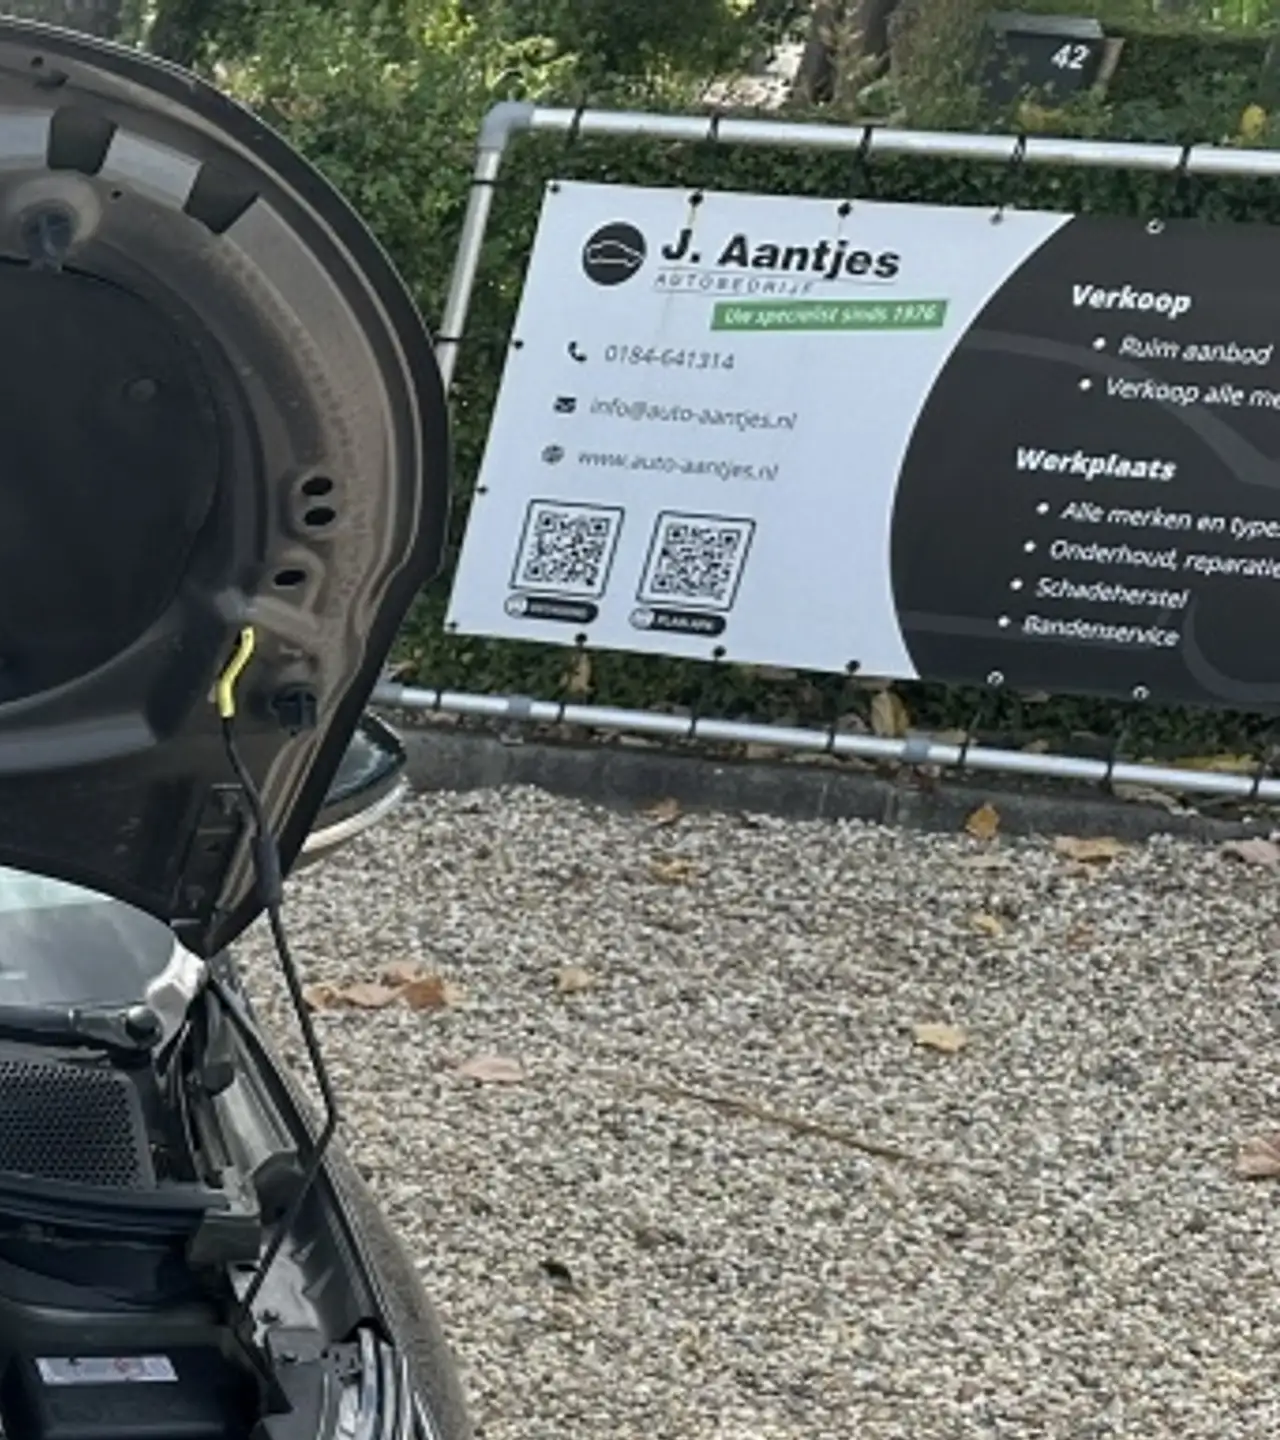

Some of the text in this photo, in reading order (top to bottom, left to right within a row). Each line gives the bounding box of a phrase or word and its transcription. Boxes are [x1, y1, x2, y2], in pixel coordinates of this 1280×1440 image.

[1051, 44, 1090, 69] 42
[661, 228, 901, 281] J. Aantjes
[655, 272, 814, 295] AUTOBEDRIJF
[755, 306, 839, 328] specialist
[841, 306, 888, 324] sinds
[893, 304, 937, 322] 1976
[1073, 284, 1191, 319] Verkoop
[604, 344, 735, 370] 0184-641314
[1118, 335, 1274, 366] Ruim aanbod
[1106, 377, 1200, 407] Verkoop
[1204, 383, 1244, 406] alle
[589, 397, 798, 431] info@auto-aantjes.nl
[577, 452, 780, 482] www.auto-aantjes.nl
[1016, 447, 1177, 481] Werkplaats
[1060, 502, 1104, 523] Alle
[1107, 507, 1192, 531] merken
[1197, 516, 1226, 532] en
[1049, 539, 1177, 571] Onderhoud,
[1035, 577, 1189, 609] Schadeherstel
[1022, 614, 1181, 647] Bandenservice
